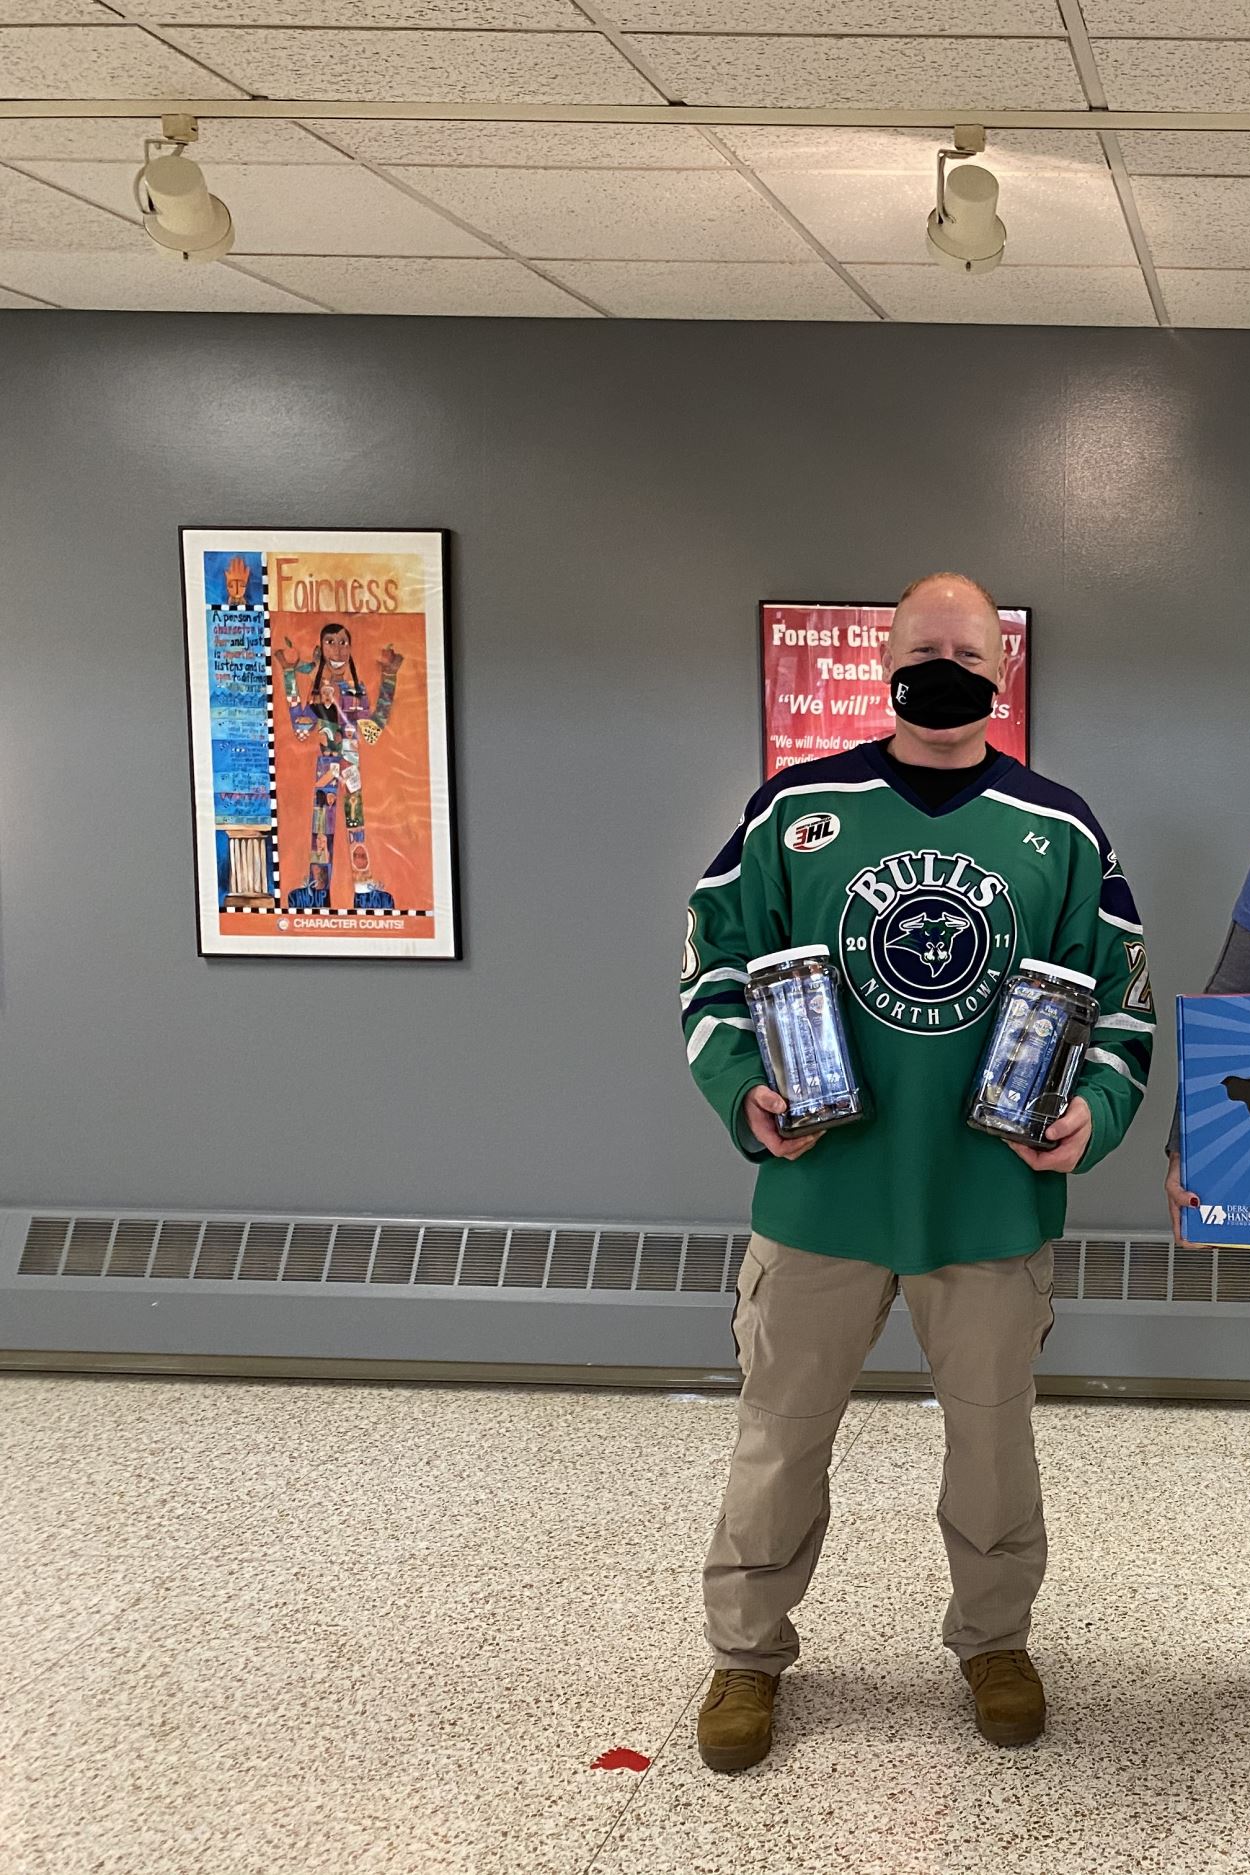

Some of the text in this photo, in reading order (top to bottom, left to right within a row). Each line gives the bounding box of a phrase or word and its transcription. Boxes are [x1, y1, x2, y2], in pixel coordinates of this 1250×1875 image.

[276, 557, 399, 613] Fairness
[213, 610, 263, 627] A person of
[230, 635, 245, 647] and
[772, 623, 840, 647] Forest
[214, 658, 243, 671] listens
[244, 661, 257, 672] and
[817, 658, 883, 681] Teach
[795, 736, 813, 750] will
[816, 736, 841, 750] hold
[793, 821, 834, 847] 3HL
[850, 853, 1006, 914] BULLS
[293, 919, 405, 930] CHARACTER COUNTS!
[846, 934, 1010, 951] 20 11
[860, 968, 1001, 1025] NORTH IOWA
